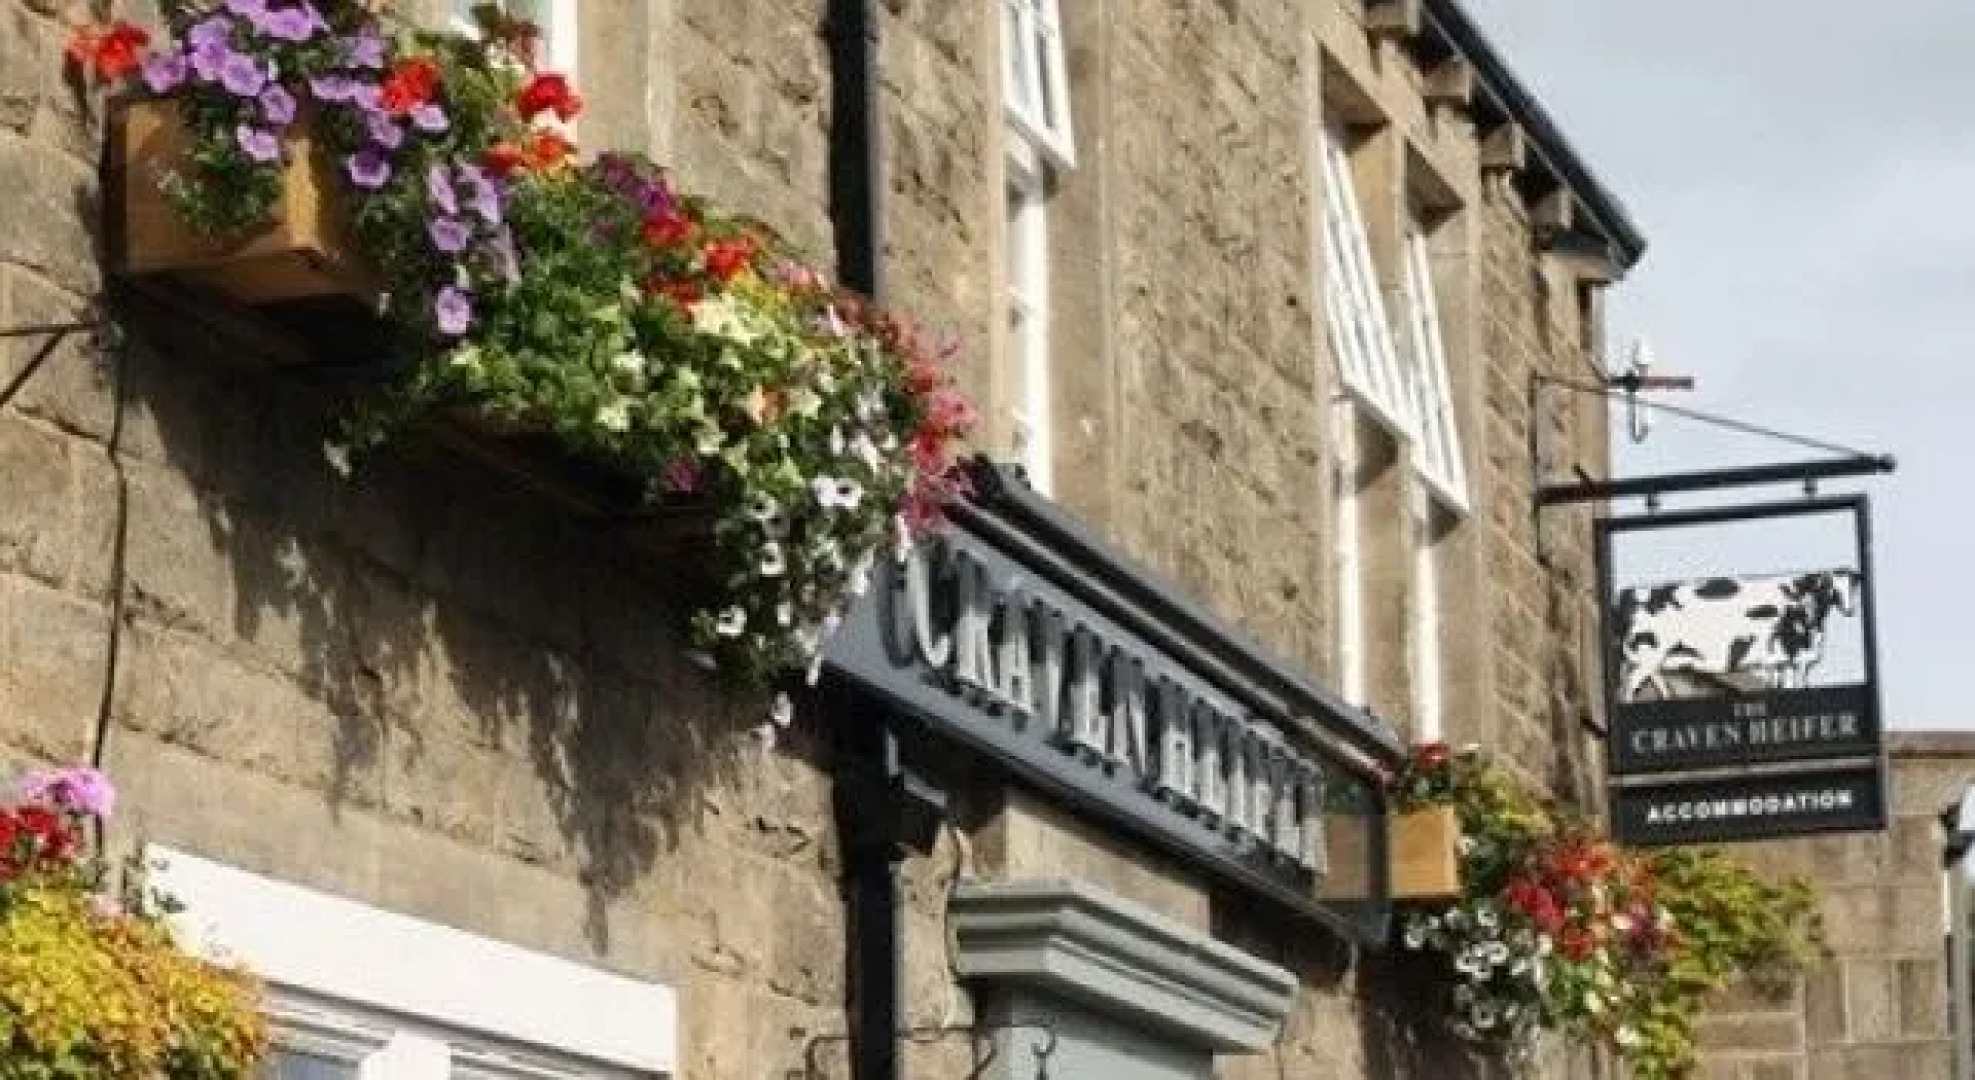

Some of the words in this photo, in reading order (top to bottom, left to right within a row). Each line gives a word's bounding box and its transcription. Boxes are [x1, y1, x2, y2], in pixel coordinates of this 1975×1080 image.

[904, 540, 1147, 776] CRAVEN
[1630, 724, 1741, 753] CRAVEN
[1749, 713, 1858, 744] HEIFER
[1647, 789, 1852, 823] ACCOMMODATION
